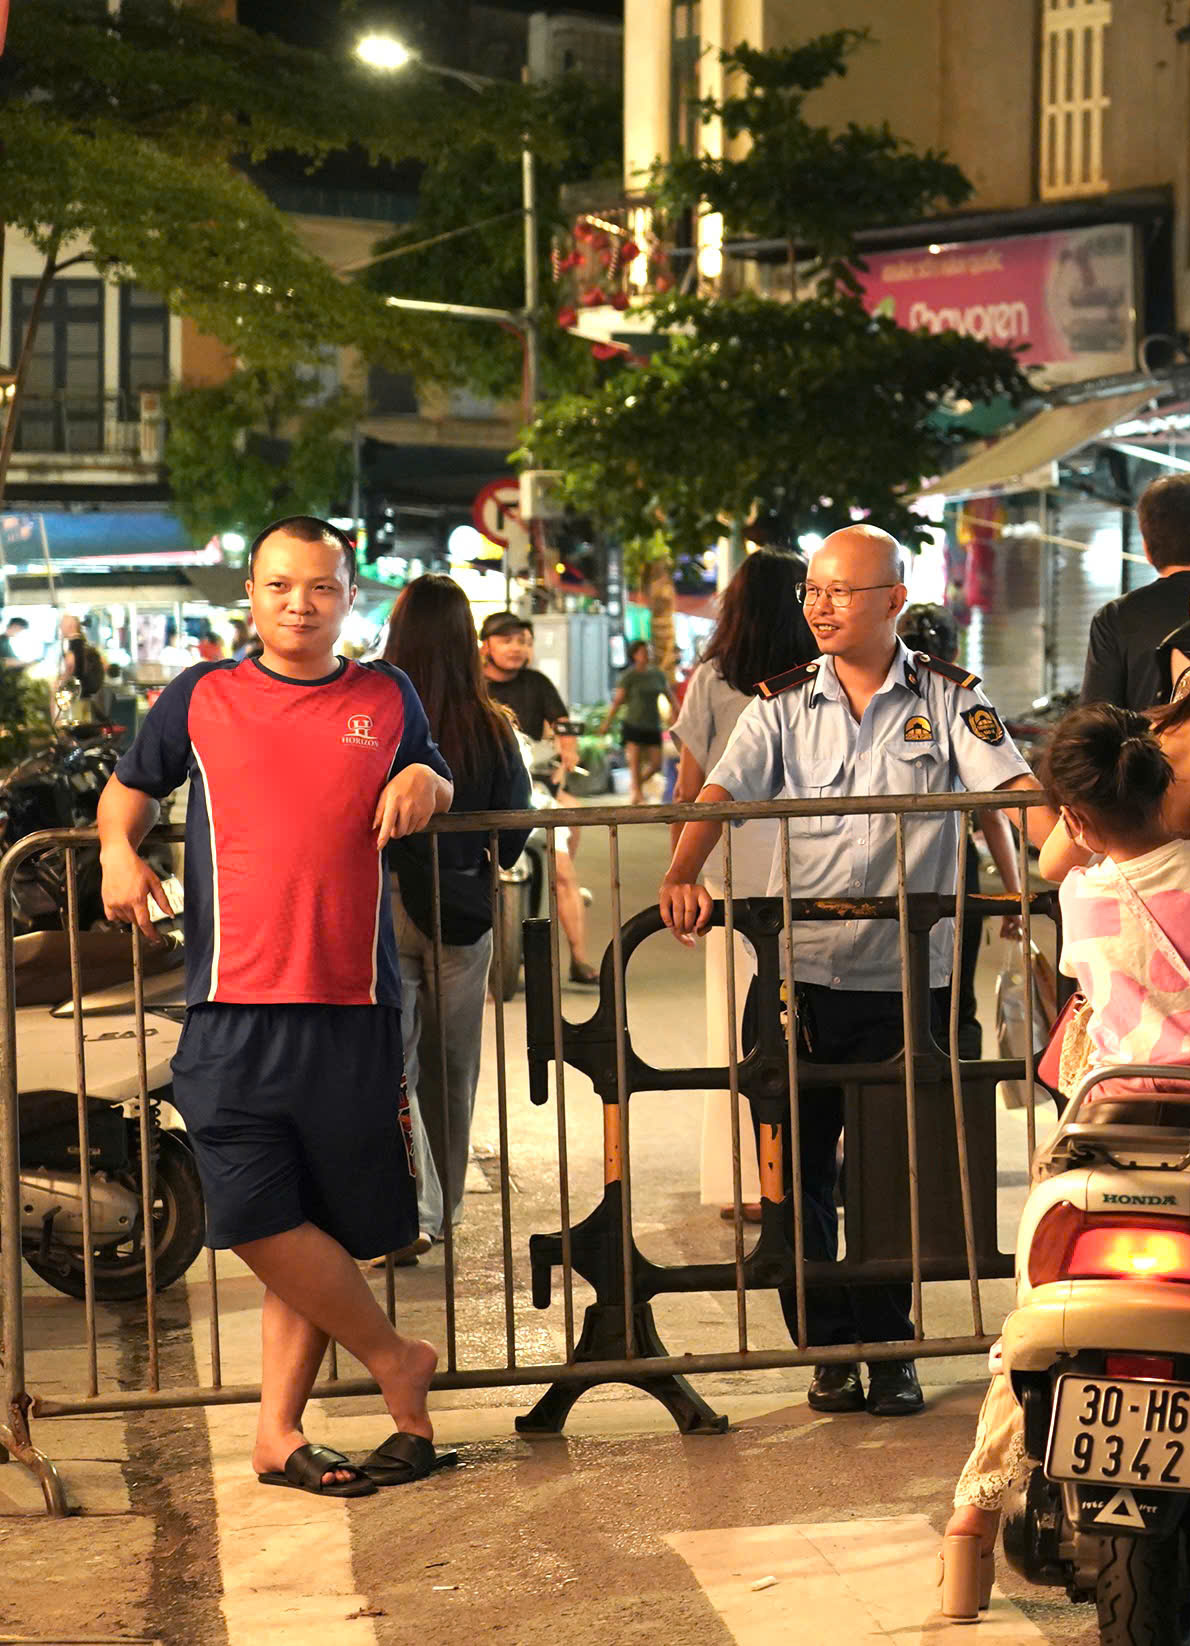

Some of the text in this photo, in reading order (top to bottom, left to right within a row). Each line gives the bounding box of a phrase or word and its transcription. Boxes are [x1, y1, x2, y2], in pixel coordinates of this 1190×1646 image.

[342, 736, 378, 748] HORIZON
[1103, 1193, 1177, 1206] HONDA
[1072, 1432, 1184, 1483] 9342
